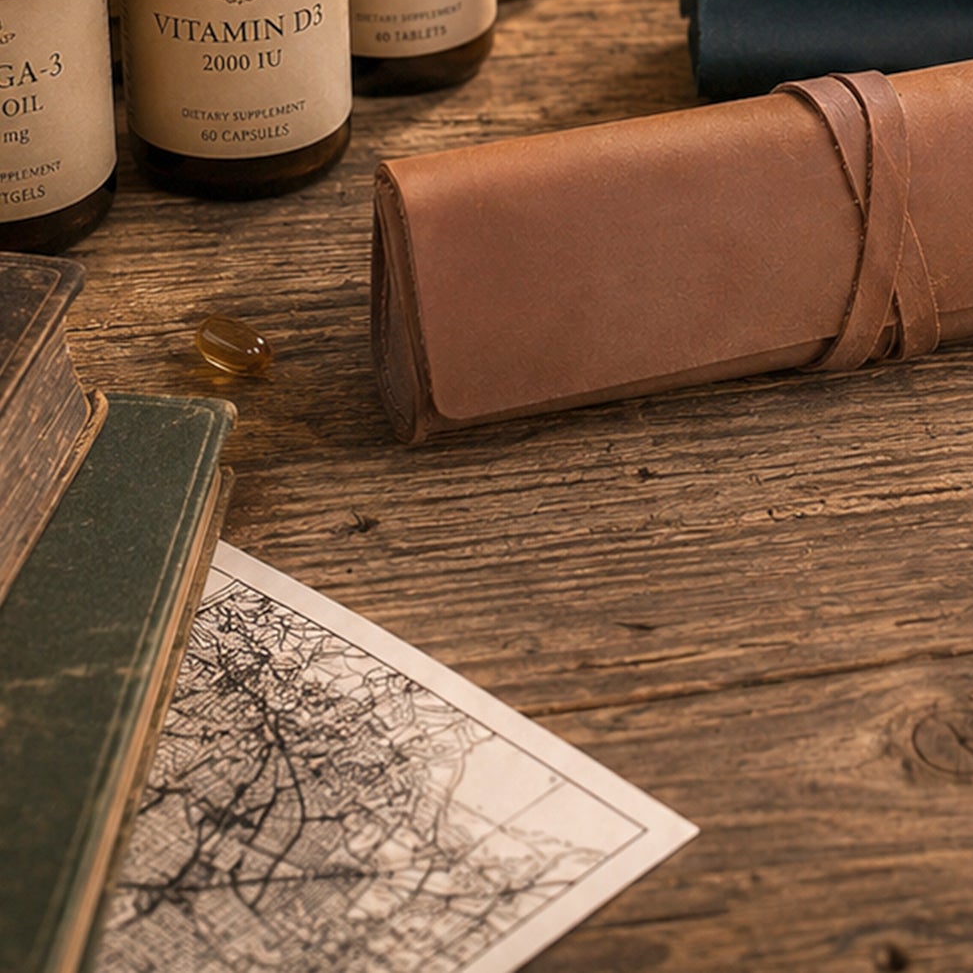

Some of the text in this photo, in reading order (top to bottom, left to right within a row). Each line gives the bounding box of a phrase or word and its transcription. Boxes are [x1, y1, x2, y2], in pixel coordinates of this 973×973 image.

[153, 3, 323, 44] VITAMIN D3
[395, 25, 448, 42] TABLETS
[202, 49, 282, 72] 2000 IU
[2, 94, 44, 118] OIL
[181, 100, 306, 122] DIETARY SUPPLEMENT
[3, 129, 31, 146] mg
[201, 123, 290, 143] 60 CAPSULES
